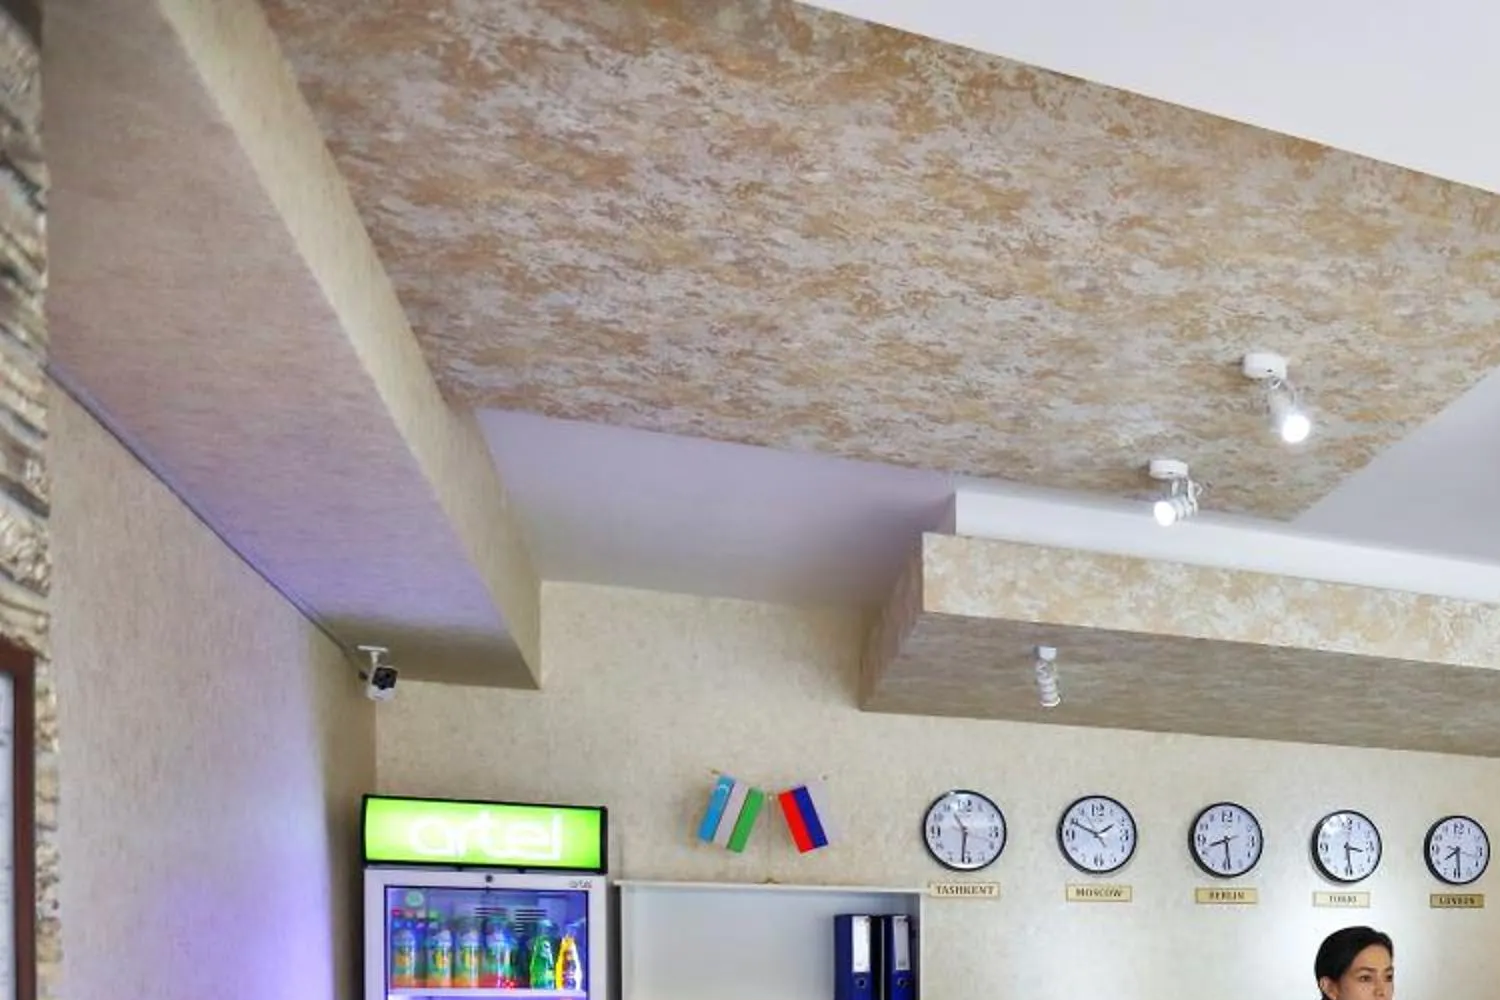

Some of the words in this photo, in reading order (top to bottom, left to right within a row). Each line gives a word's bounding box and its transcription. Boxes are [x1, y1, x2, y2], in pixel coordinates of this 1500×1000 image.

[1091, 803, 1105, 816] 12
[409, 810, 563, 860] artel
[936, 885, 995, 895] TASHKENT
[1075, 887, 1124, 897] MOSCOW
